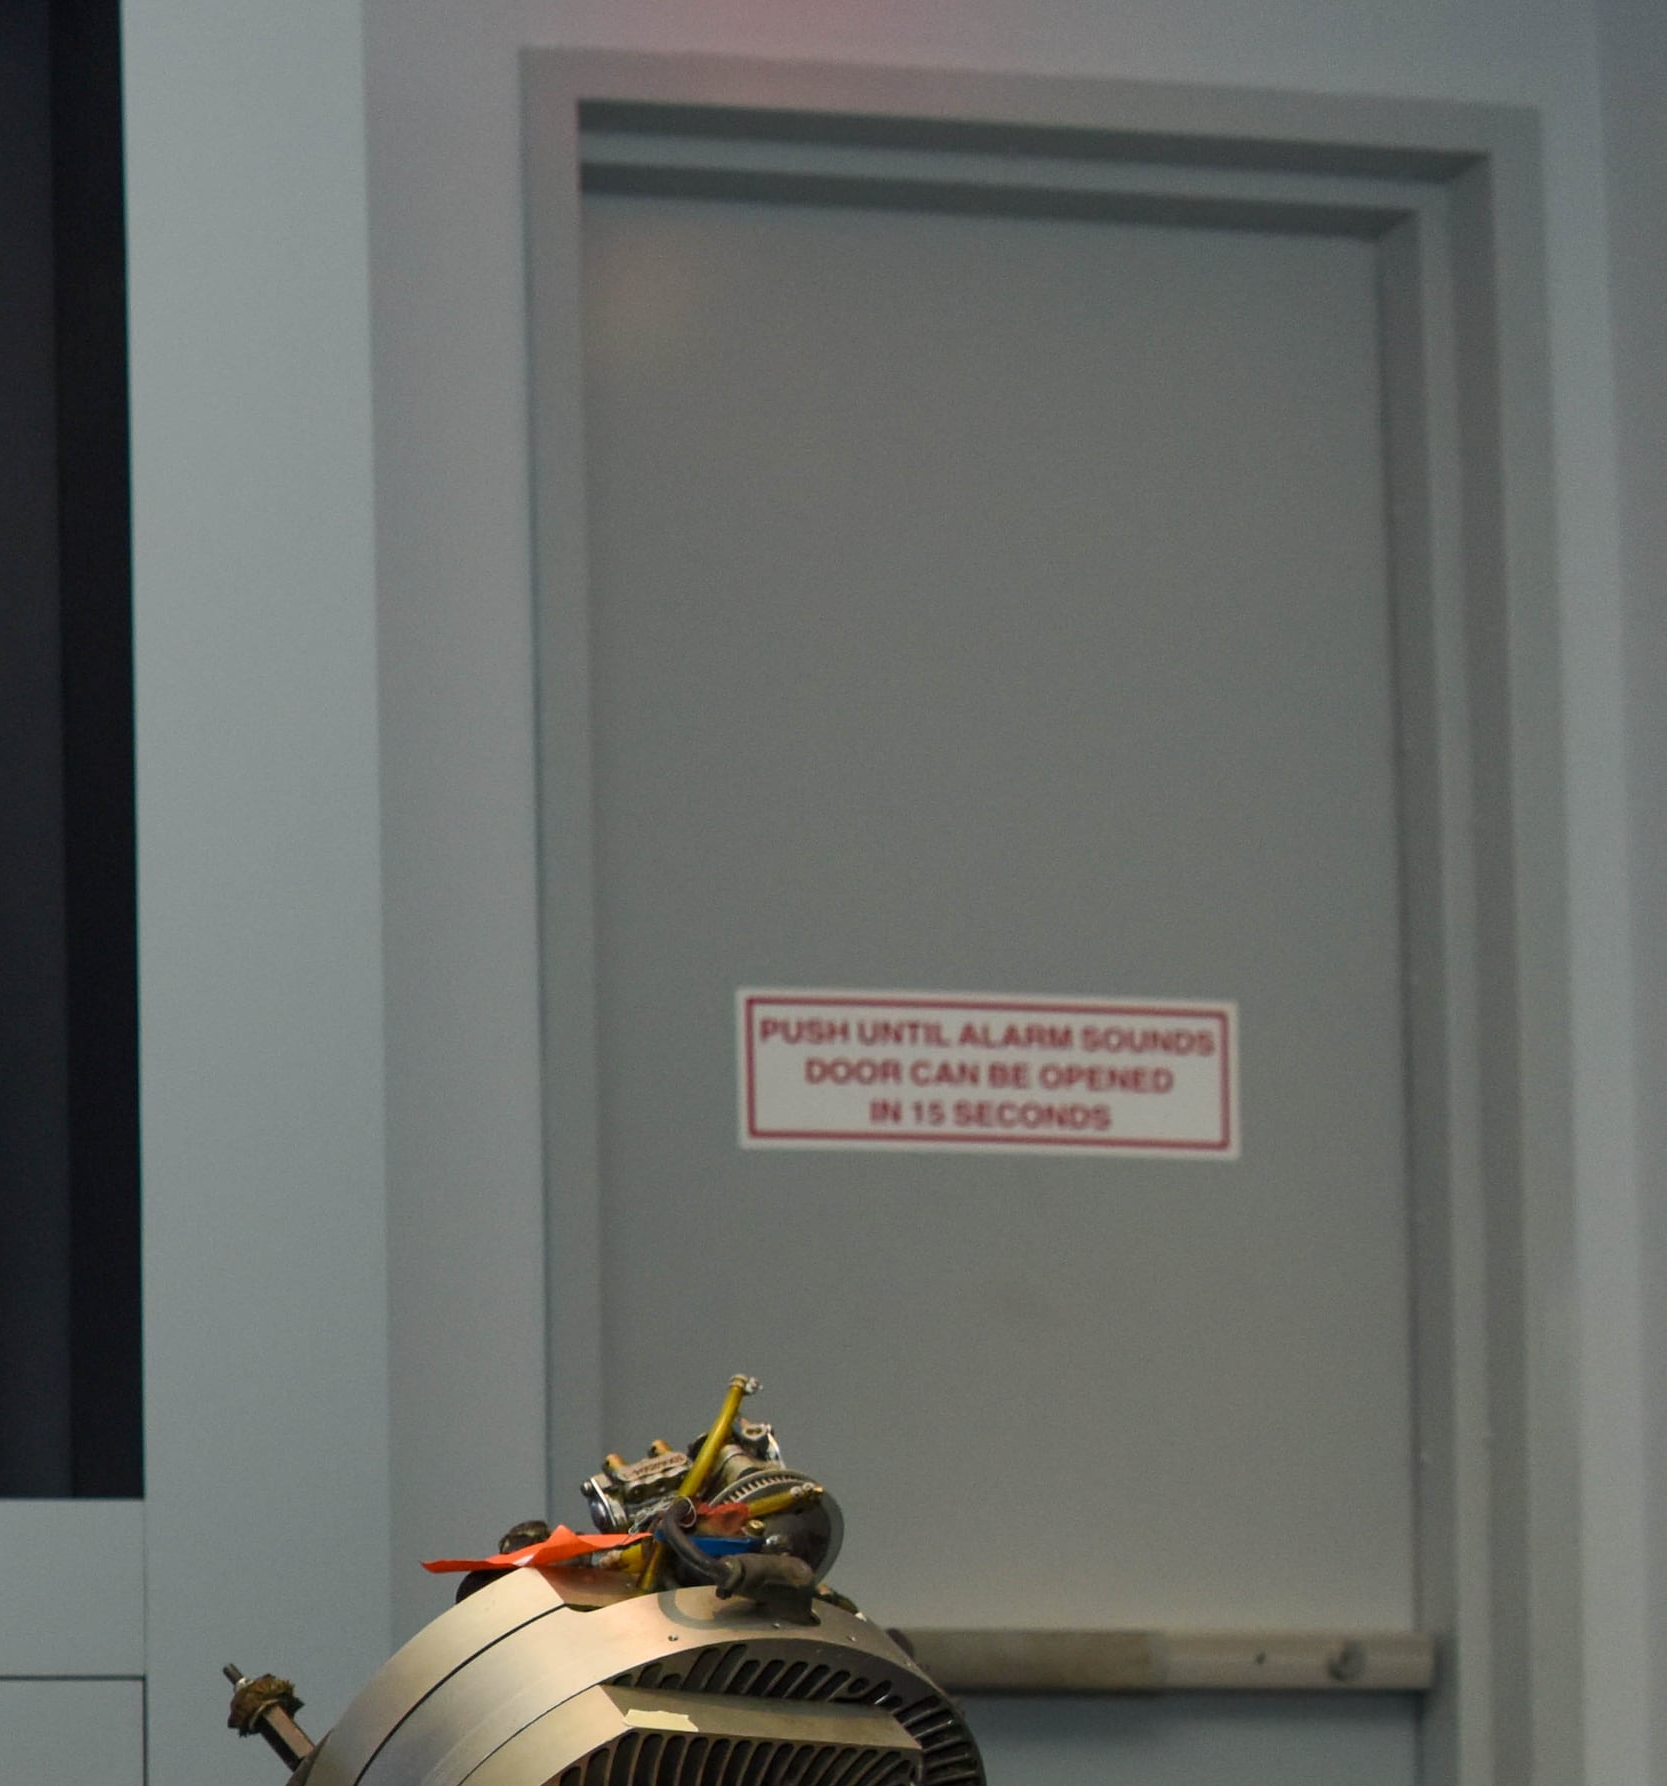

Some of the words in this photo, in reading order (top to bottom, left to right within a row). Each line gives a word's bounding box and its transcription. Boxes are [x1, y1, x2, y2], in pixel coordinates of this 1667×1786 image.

[759, 1018, 850, 1045] PUSH
[856, 1021, 950, 1048] UNTIL
[959, 1023, 1073, 1051] ALARM
[1079, 1026, 1216, 1057] SOUNDS
[804, 1058, 901, 1086] DOOR
[909, 1060, 980, 1087] CAN
[987, 1063, 1031, 1089] BE
[1038, 1064, 1175, 1095] OPENED
[869, 1098, 902, 1125] IN
[913, 1100, 945, 1126] 15
[953, 1102, 1113, 1132] SECONDS
